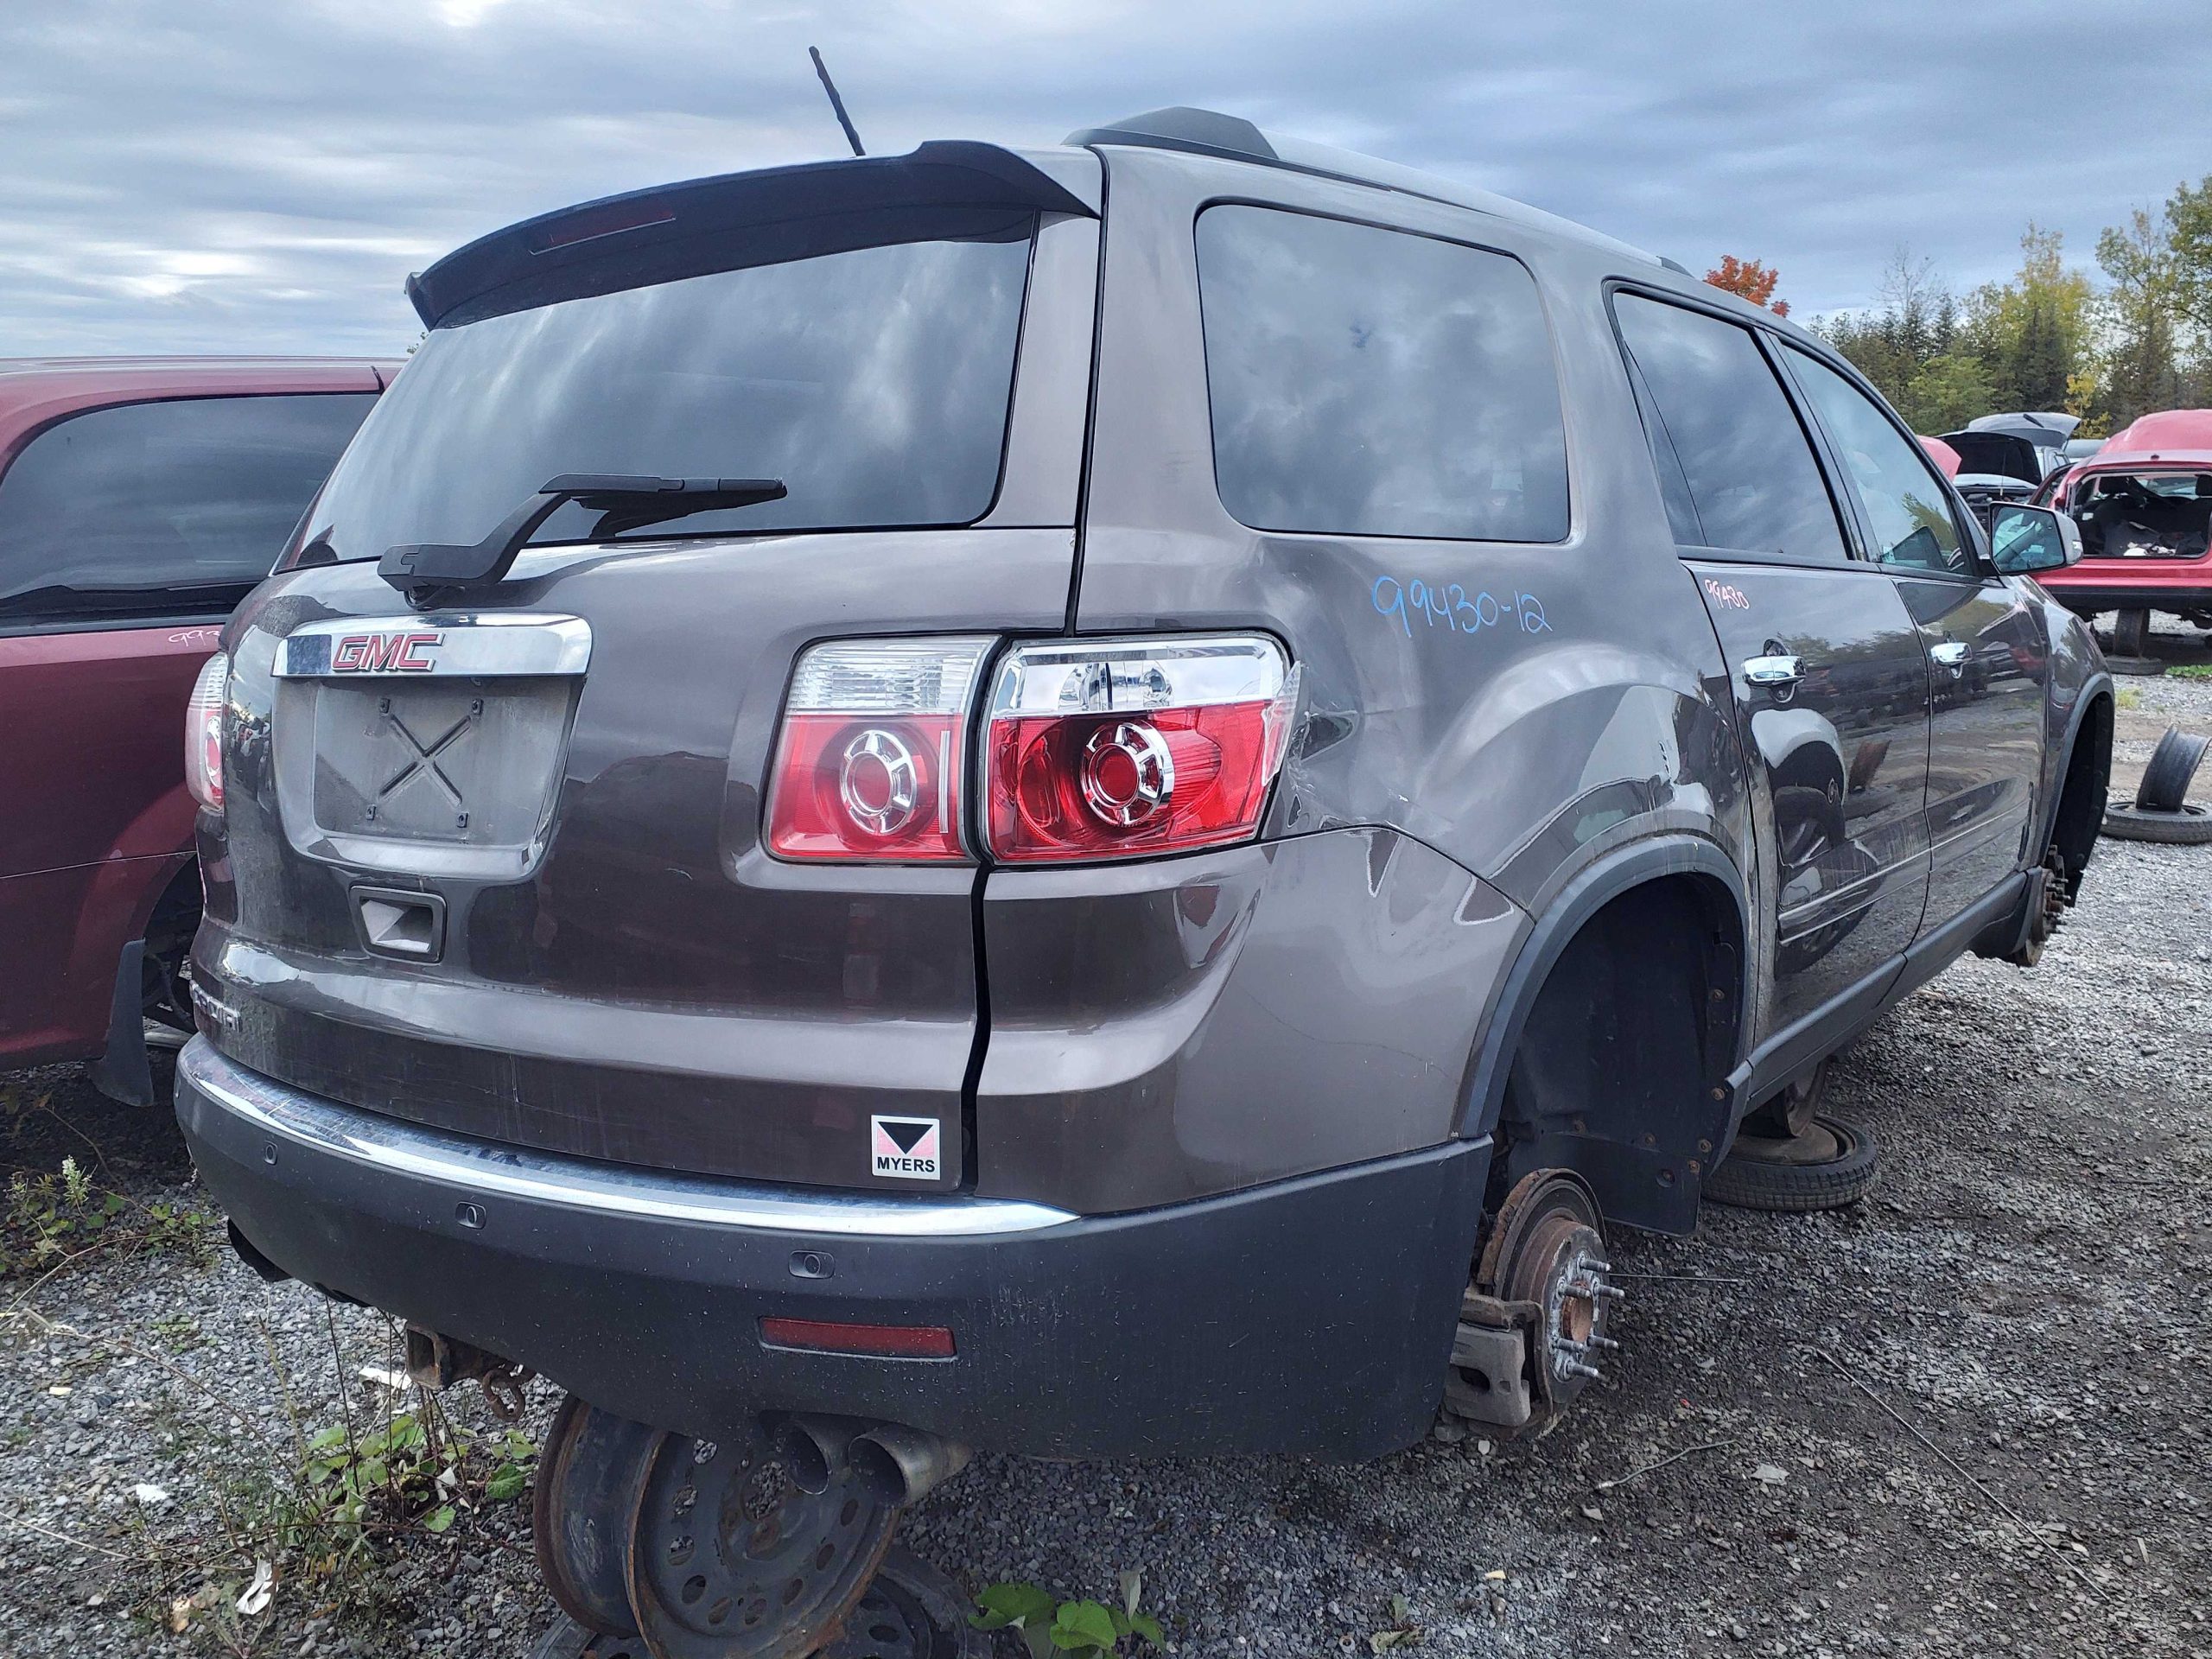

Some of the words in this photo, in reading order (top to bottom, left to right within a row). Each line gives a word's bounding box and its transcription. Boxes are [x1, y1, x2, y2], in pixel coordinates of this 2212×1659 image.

[1371, 575, 1554, 638] 99430-12
[332, 632, 446, 673] GMC
[877, 1157, 936, 1173] MYERS
